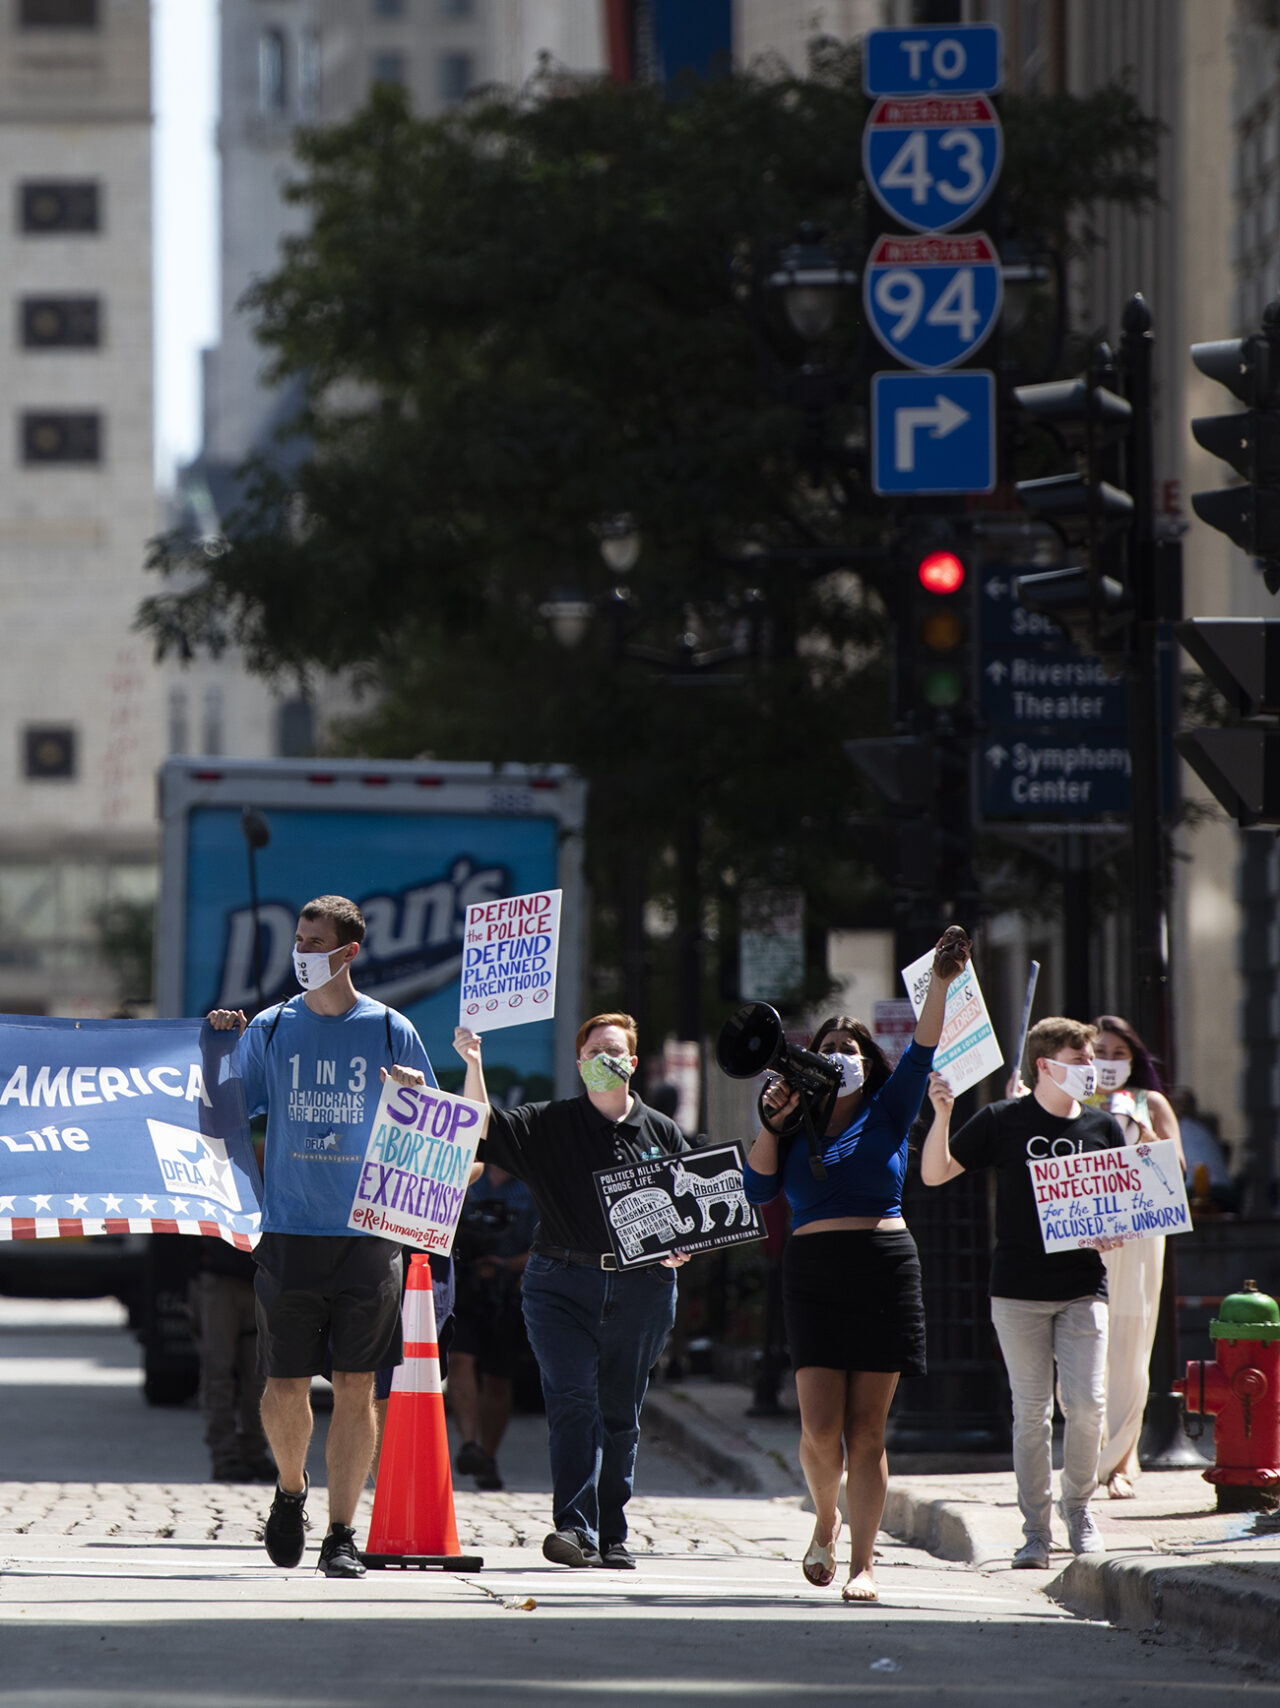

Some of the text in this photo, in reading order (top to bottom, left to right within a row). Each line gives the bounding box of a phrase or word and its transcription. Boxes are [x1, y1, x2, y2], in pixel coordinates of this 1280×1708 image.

[900, 39, 967, 80] TO
[886, 103, 979, 121] INTERSTATE
[879, 129, 986, 205] 43
[886, 243, 979, 262] INTERSTATE
[875, 270, 981, 342] 94
[1012, 692, 1104, 719] Theater
[1012, 742, 1132, 777] Symphony
[1012, 776, 1092, 803] Center
[470, 895, 551, 925] DEFUND
[218, 859, 509, 1010] Dan's
[466, 913, 552, 943] the POLICE
[466, 935, 551, 968] DEFUND
[463, 970, 551, 1000] PARENTHOOD
[464, 956, 546, 984] PLANNED
[0, 1064, 213, 1107] AMERICA
[288, 1054, 368, 1092] 1 IN 3
[288, 1090, 366, 1108] DEMOCRATS
[288, 1106, 365, 1124] ARE PRO-LIFE
[386, 1087, 479, 1143] STOP
[368, 1123, 471, 1187] ABORTION
[1034, 1151, 1130, 1182] NO LETHAL
[160, 1158, 207, 1187] DFLA
[599, 1168, 635, 1186] POLITICS
[636, 1162, 664, 1178] KILLS.
[602, 1175, 656, 1195] CHOOSE LIFE.
[693, 1176, 742, 1196] ABORTION
[1037, 1169, 1142, 1204] INJECTIONS
[358, 1162, 465, 1227] EXTREMISM
[613, 1196, 644, 1217] CAPITAL
[1042, 1203, 1064, 1221] for
[1069, 1200, 1089, 1218] the
[1131, 1192, 1154, 1211] the
[352, 1207, 449, 1249] @RehumanizeIntl
[612, 1201, 658, 1229] PUNISHMENT
[1113, 1221, 1128, 1233] the
[1131, 1204, 1187, 1232] UNBORN
